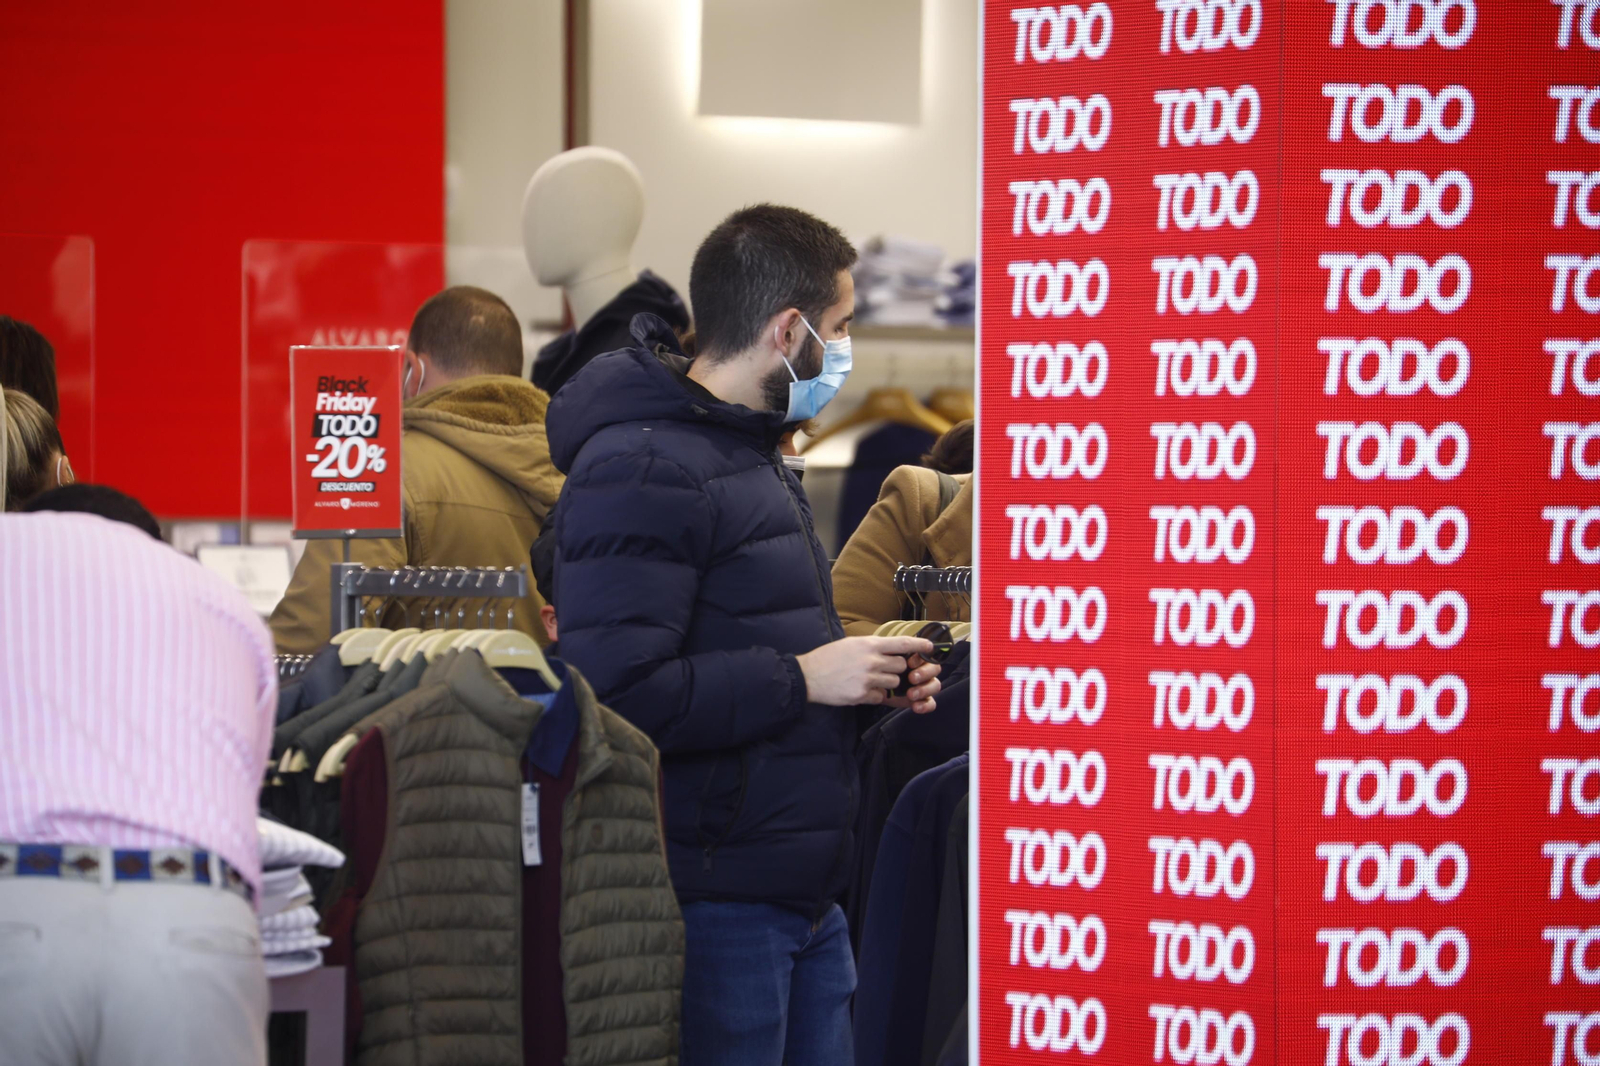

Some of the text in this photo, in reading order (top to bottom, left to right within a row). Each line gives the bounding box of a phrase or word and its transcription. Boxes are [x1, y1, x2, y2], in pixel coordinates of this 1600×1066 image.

[1010, 0, 1262, 63] TODO TODO
[1326, 0, 1476, 48] TODO
[1008, 84, 1261, 155] TODO TODO
[1321, 83, 1600, 143] TODO TO
[1008, 169, 1260, 236] TODO TODO
[1320, 168, 1600, 228] TODO TO
[1006, 253, 1258, 319] TODO TODO
[1318, 253, 1600, 314] TODO TO
[316, 376, 368, 392] Black
[1005, 337, 1257, 399] TODO TODO
[1316, 337, 1600, 396] TODO TO
[315, 391, 376, 415] Friday
[318, 414, 377, 437] TODO
[306, 436, 387, 478] -20%
[1005, 420, 1257, 480] TODO TODO
[1315, 421, 1600, 480] TODO TO
[320, 482, 374, 492] DESCUENTO
[1005, 504, 1256, 564] TODO TODO
[1315, 505, 1600, 565] TODO TO
[1004, 584, 1255, 648] TODO TODO
[1315, 589, 1600, 649] TODO TO
[1004, 666, 1255, 732] TODO TODO
[1315, 673, 1600, 734] TODO TO
[1004, 747, 1255, 815] TODO TODO
[1314, 758, 1600, 817] TODO TO
[1004, 827, 1255, 899] TODO TODO
[1315, 842, 1600, 902] TODO TO
[1004, 909, 1255, 984] TODO TODO
[1315, 927, 1600, 987] TODO TO
[1005, 991, 1255, 1066] TODO TODO
[1316, 1012, 1600, 1066] TODO TO
